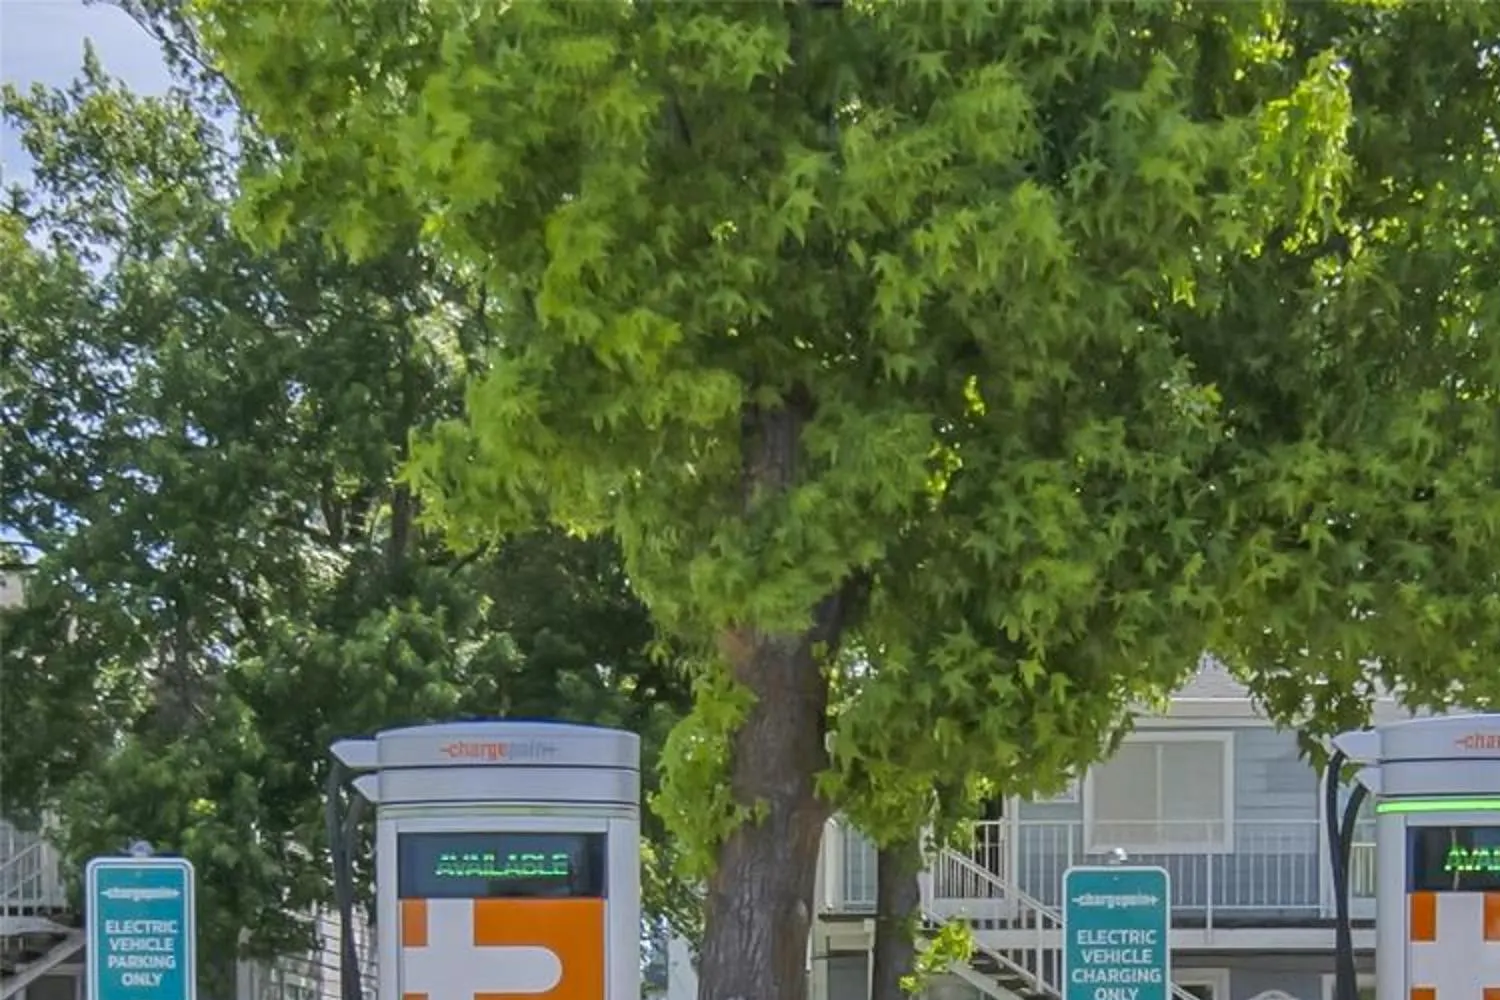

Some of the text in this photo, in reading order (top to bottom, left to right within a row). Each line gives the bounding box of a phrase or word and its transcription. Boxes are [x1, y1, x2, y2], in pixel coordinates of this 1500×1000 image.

[434, 852, 570, 878] AVAILABLE
[105, 919, 179, 934] ELECTRIC
[109, 937, 174, 952] VEHICLE
[1077, 929, 1157, 945] ELECTRIC
[107, 955, 176, 969] PARKING
[1081, 948, 1153, 964] VEHICLE
[121, 973, 163, 986] ONLY
[1071, 968, 1162, 983] CHARGING
